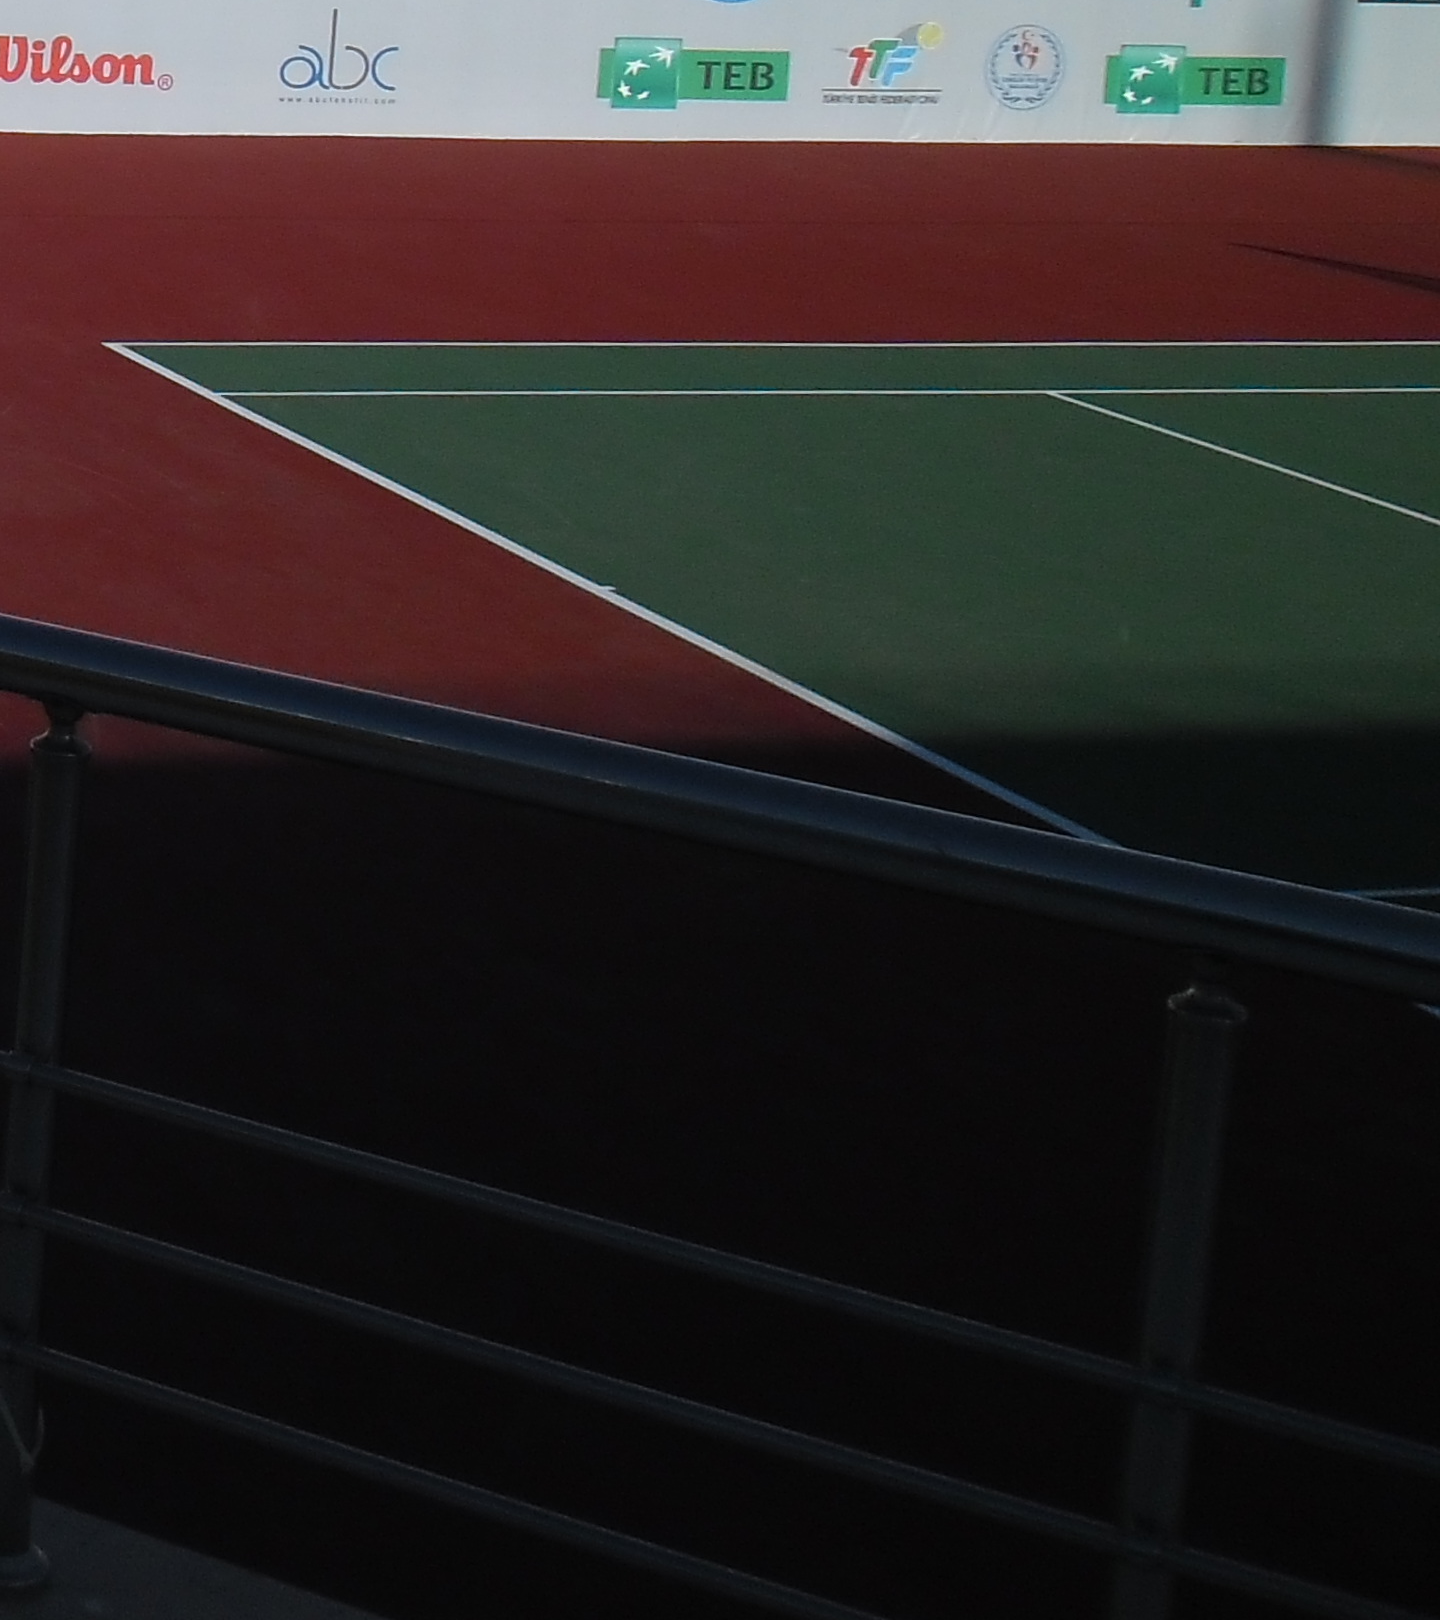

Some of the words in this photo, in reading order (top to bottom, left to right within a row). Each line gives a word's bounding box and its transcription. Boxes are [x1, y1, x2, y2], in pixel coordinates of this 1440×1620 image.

[280, 8, 400, 91] abc
[697, 61, 775, 91] TEB
[1198, 67, 1270, 96] TEB
